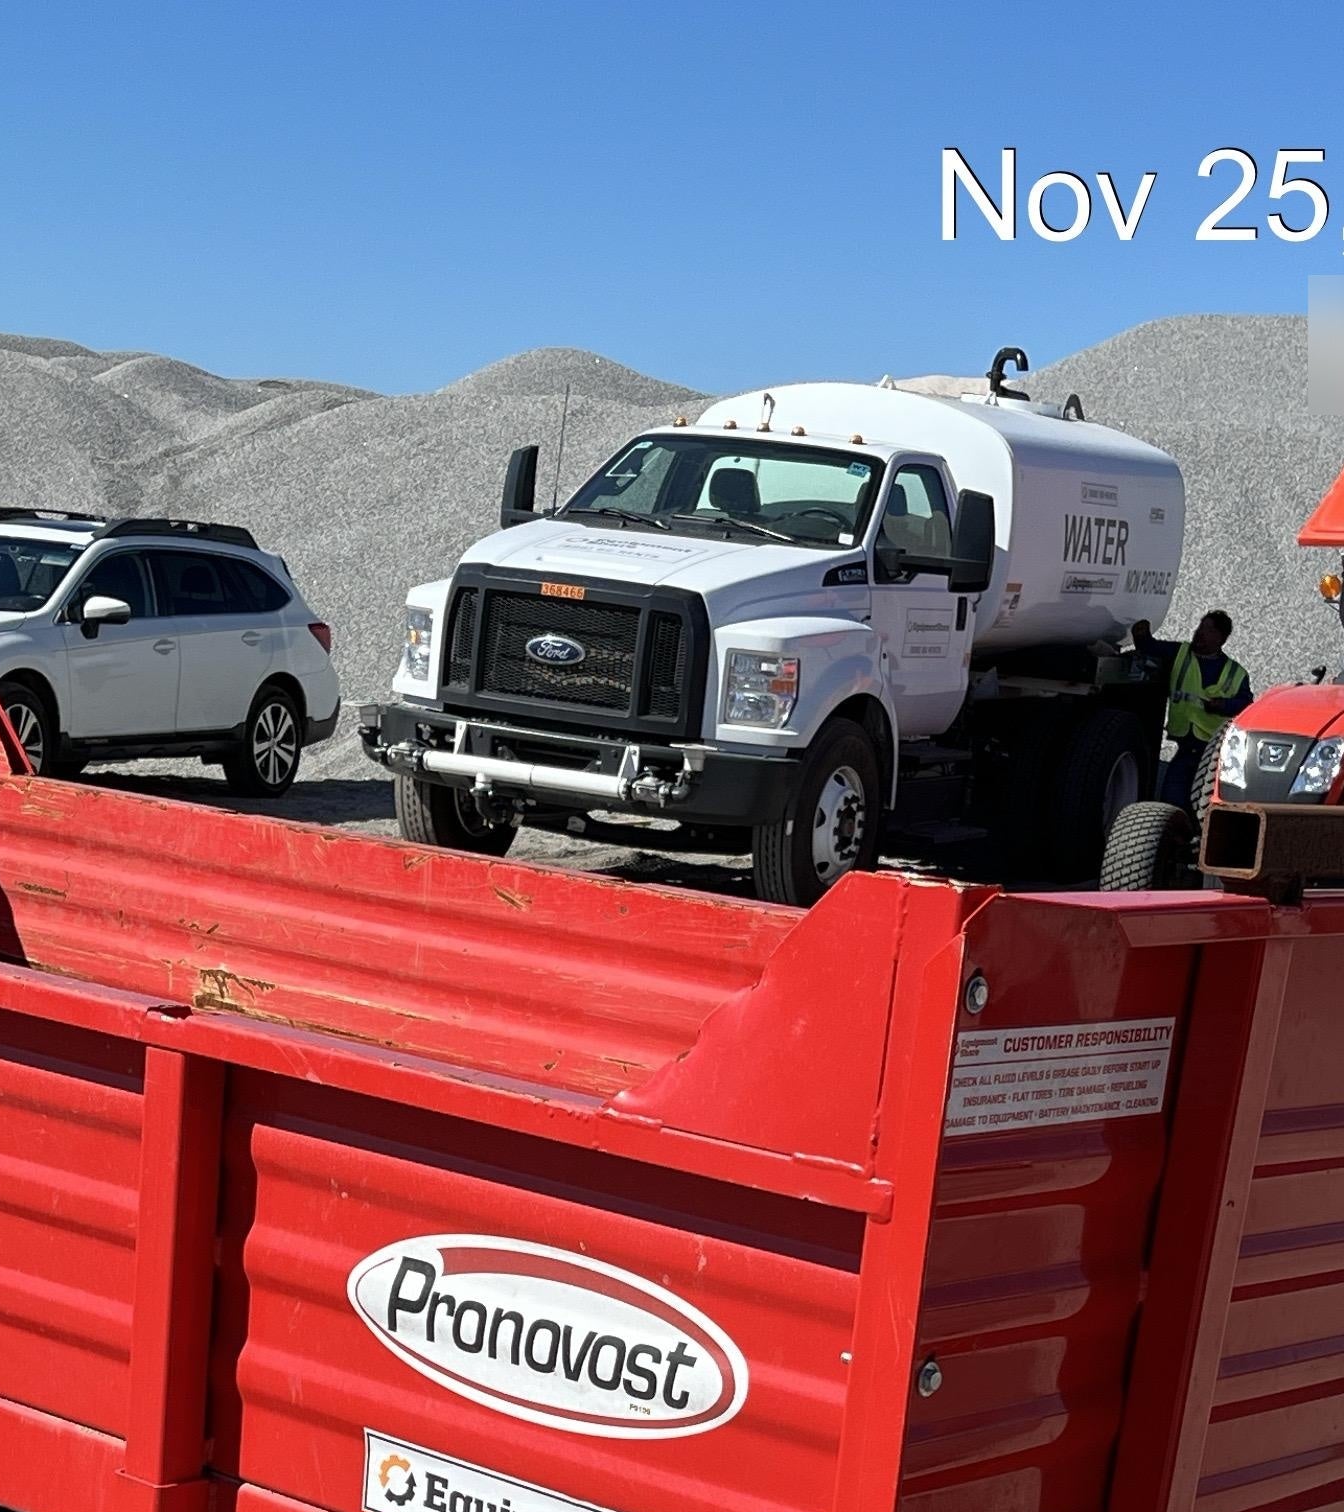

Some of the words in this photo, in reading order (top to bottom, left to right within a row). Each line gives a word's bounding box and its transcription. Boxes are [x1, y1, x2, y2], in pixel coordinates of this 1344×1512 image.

[1063, 513, 1129, 566] WATER
[542, 583, 583, 598] 368466
[536, 639, 569, 660] Ford
[1003, 1033, 1073, 1053] CUSTOMER
[1076, 1026, 1173, 1047] RESPONSIBILITY
[953, 1075, 977, 1088] CHECK
[978, 1074, 993, 1086] ALL
[1017, 1070, 1044, 1082] LEVELS
[1052, 1067, 1080, 1079] GREASE
[1103, 1062, 1129, 1074] BEFORE
[963, 1093, 1007, 1108] INSURANCE
[1012, 1091, 1029, 1102] FLAT
[1031, 1089, 1053, 1100] TIRES
[1076, 1084, 1106, 1097] DAMAGE
[1110, 1080, 1148, 1093] REFUELING
[989, 1110, 1034, 1125] EQUIPMENT
[1038, 1106, 1070, 1119] BATTERY
[386, 1256, 698, 1411] Pronovost
